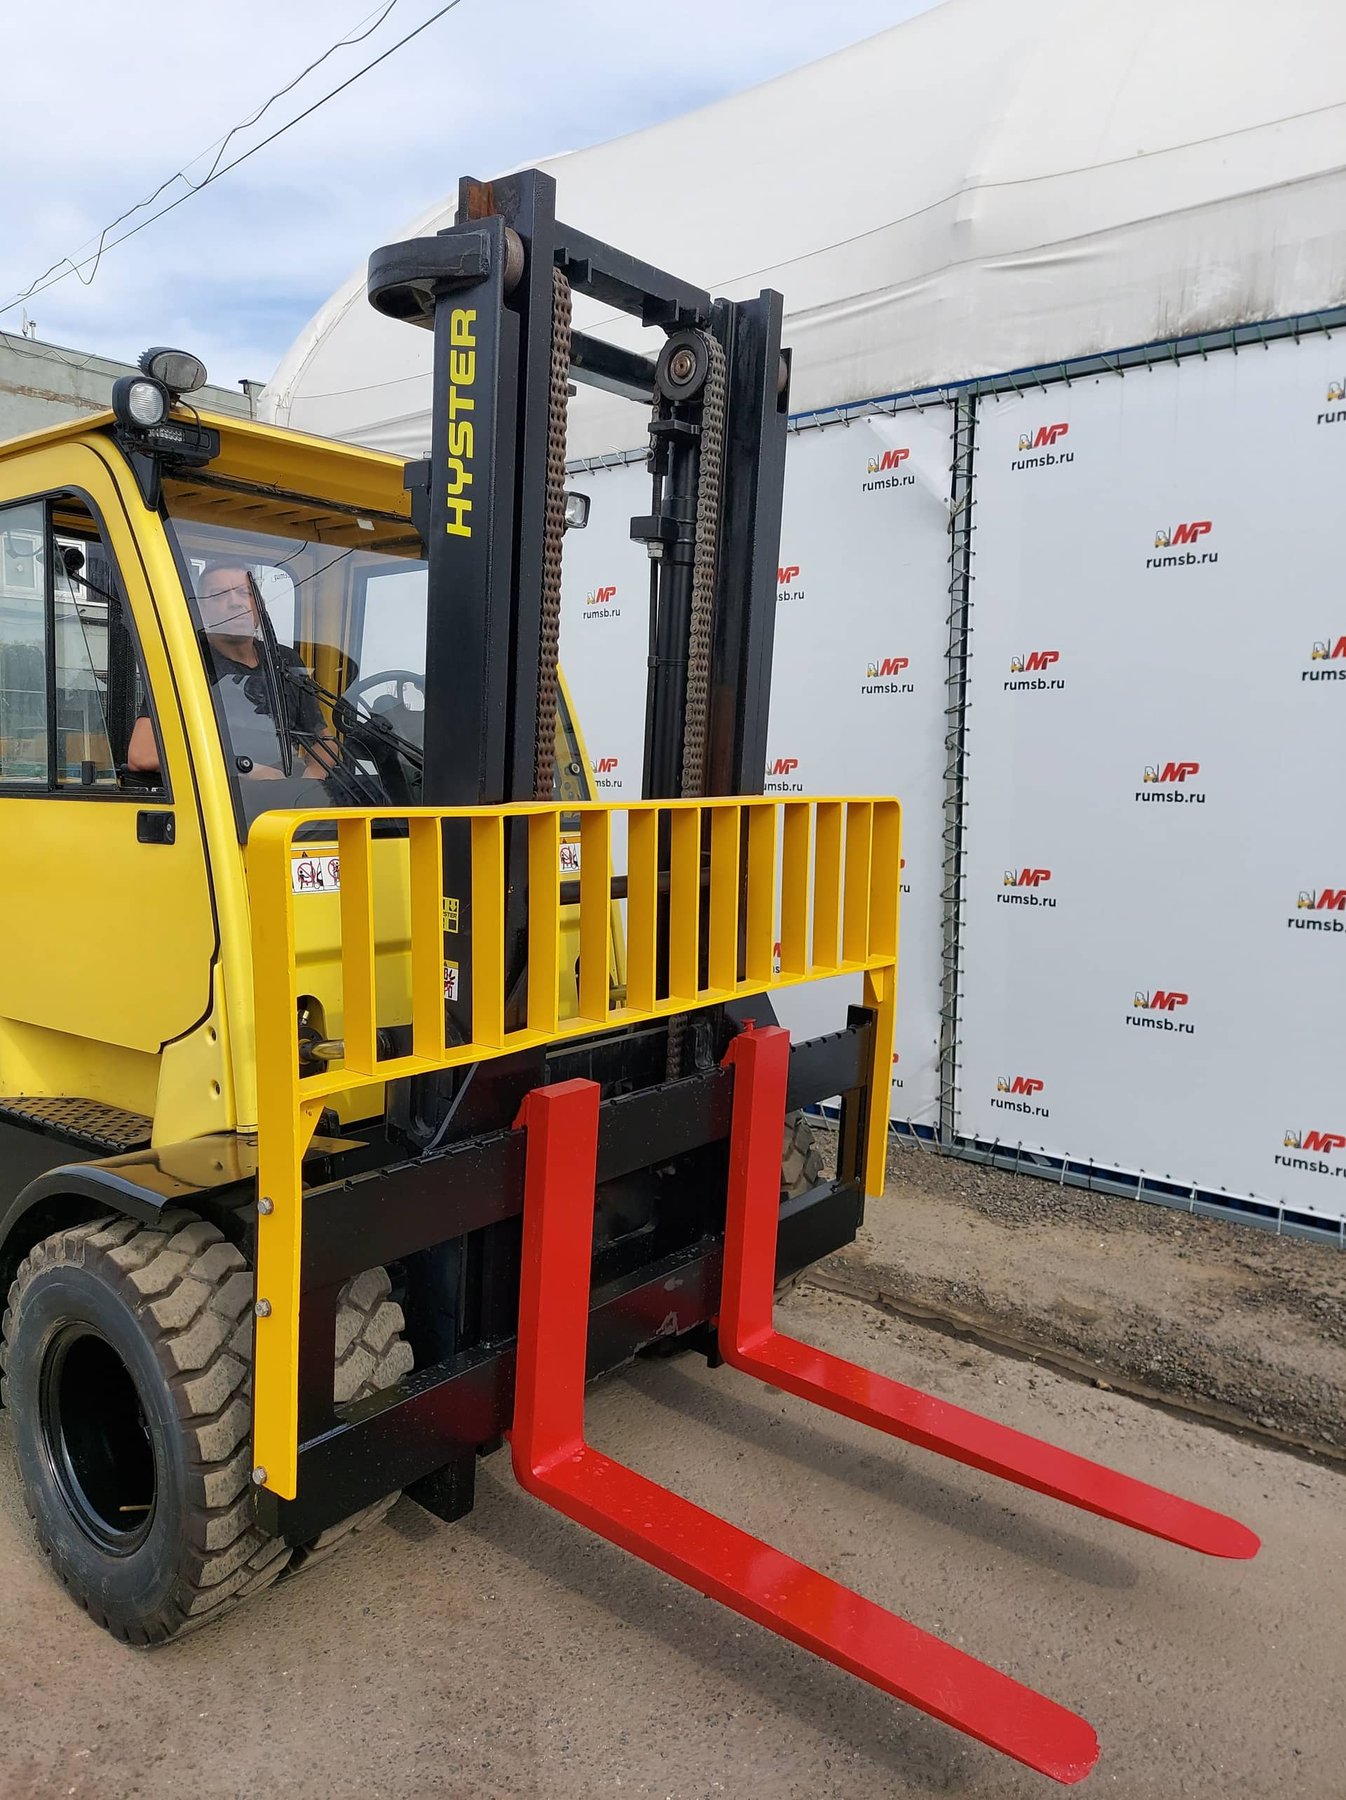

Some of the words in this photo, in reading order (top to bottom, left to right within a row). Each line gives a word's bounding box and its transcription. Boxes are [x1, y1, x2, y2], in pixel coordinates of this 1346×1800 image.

[446, 308, 477, 538] HYSTER
[1012, 450, 1074, 471] rumsb.ru
[862, 474, 915, 492] rumsb.ru
[1146, 550, 1218, 569] rumsb.ru
[778, 590, 805, 602] sb.ru
[583, 607, 621, 619] rumsb.ru
[1302, 669, 1346, 681] rums
[861, 681, 914, 694] rumsb.ru
[1003, 677, 1065, 691] rumsb.ru
[764, 781, 803, 791] msb.ru
[1136, 789, 1206, 804] rumsb.ru
[997, 893, 1057, 907] rumsb.ru
[1288, 918, 1346, 932] rumsb
[1126, 1014, 1195, 1034] rumsb.ru
[990, 1097, 1049, 1118] rumsb.ru
[1274, 1154, 1346, 1178] rumsb.r
